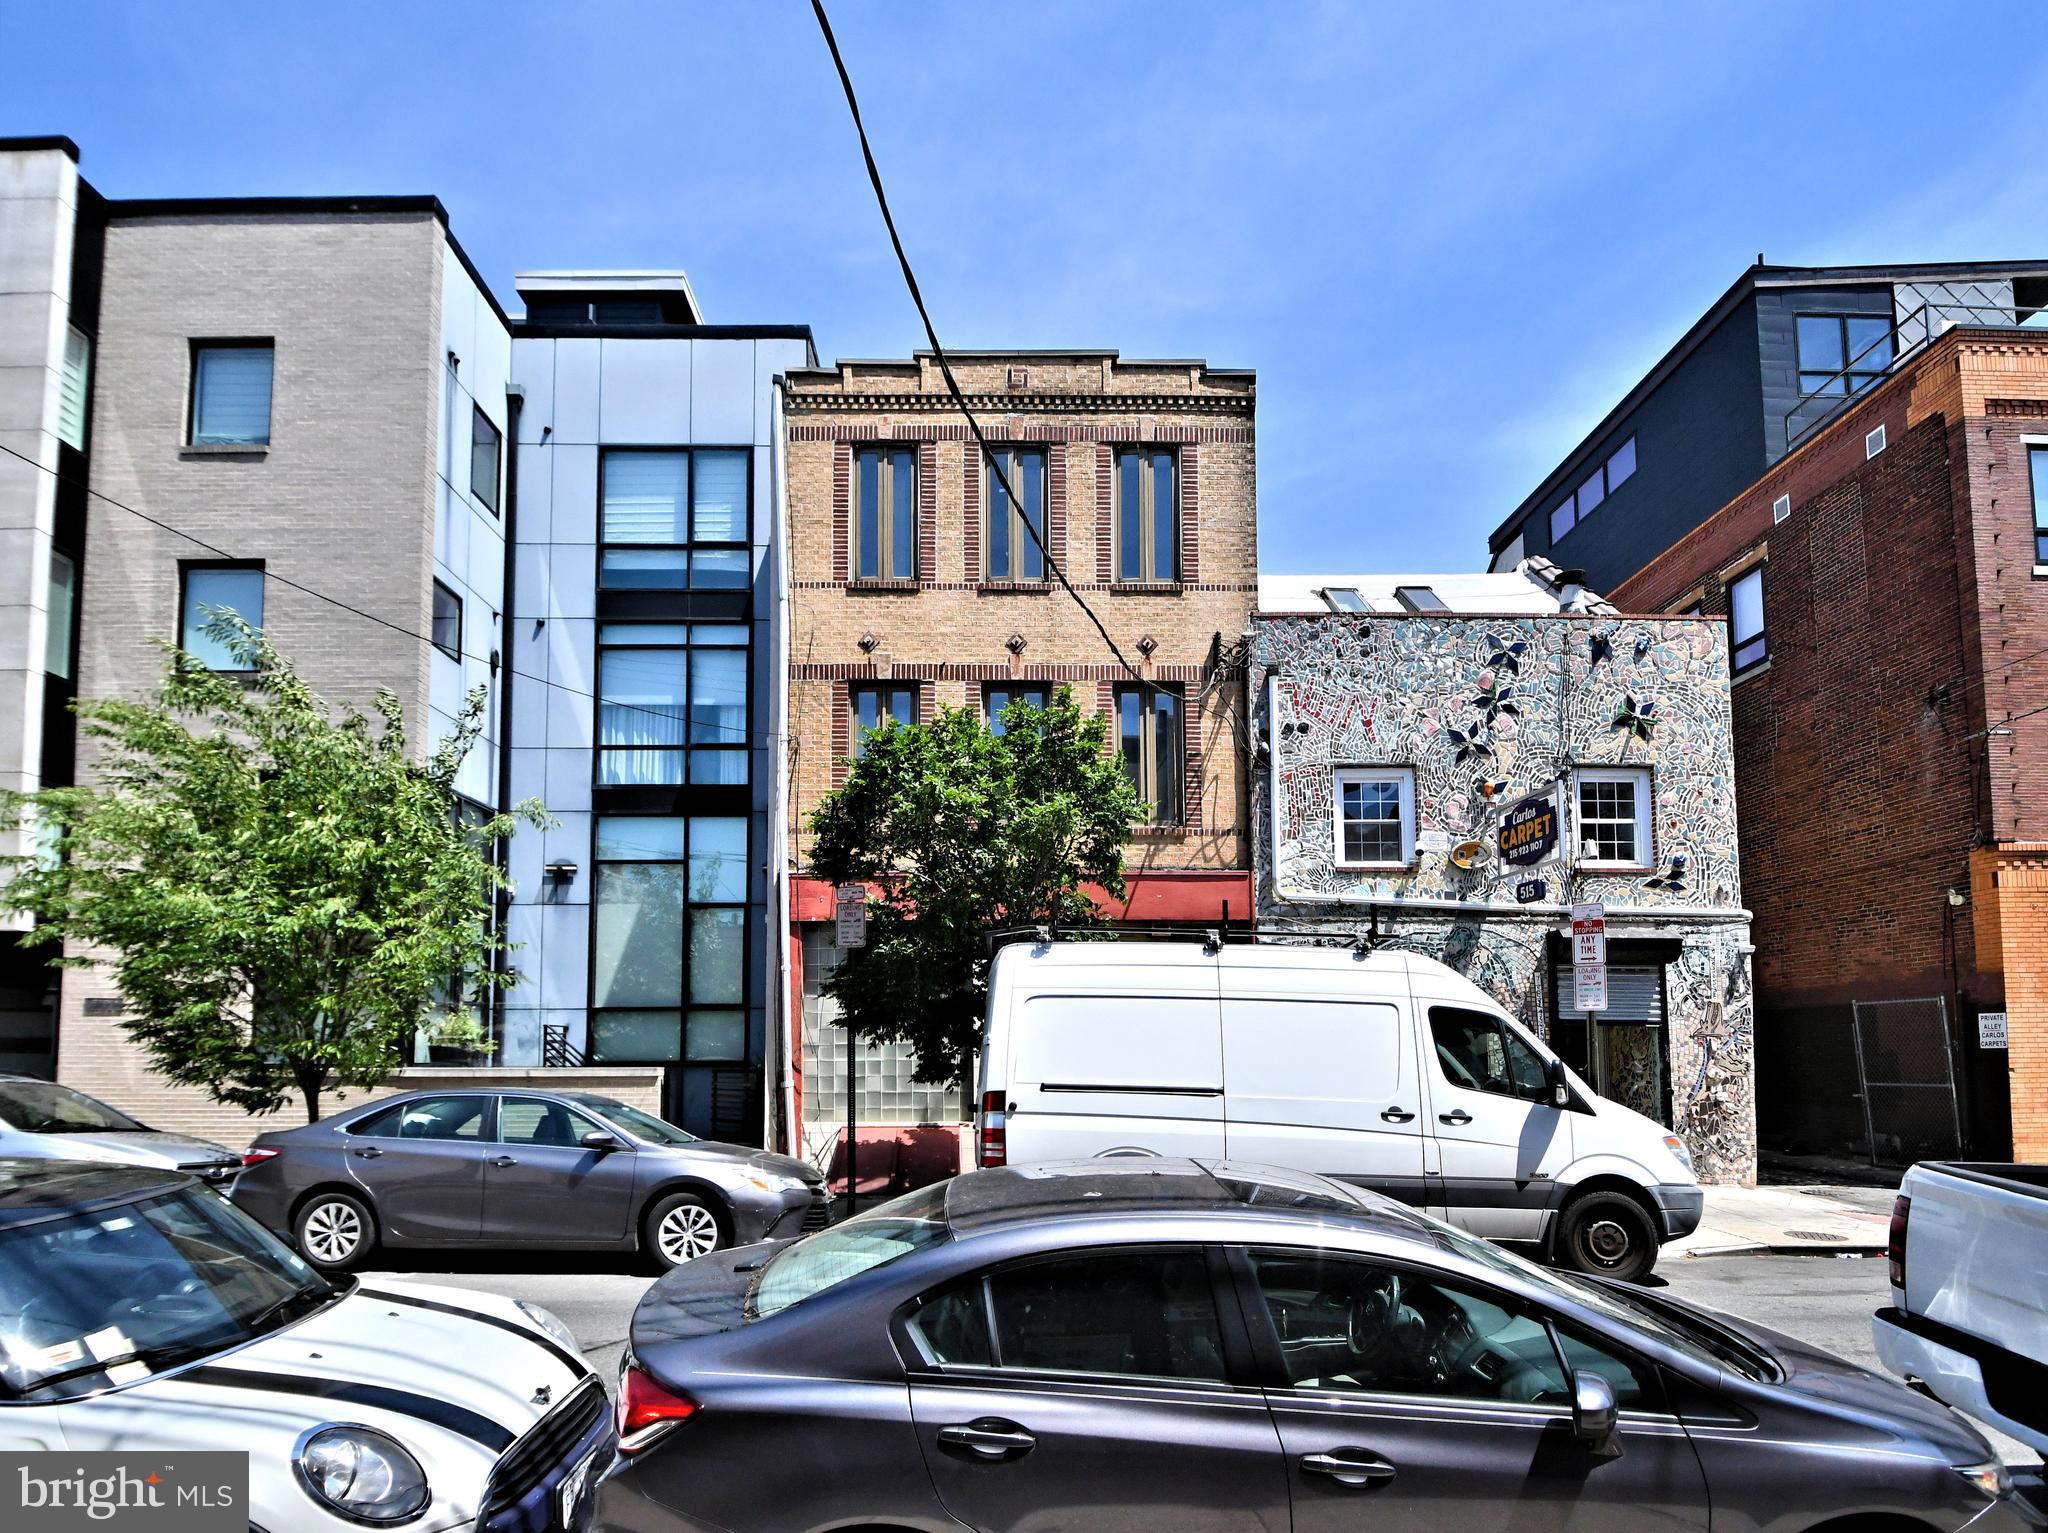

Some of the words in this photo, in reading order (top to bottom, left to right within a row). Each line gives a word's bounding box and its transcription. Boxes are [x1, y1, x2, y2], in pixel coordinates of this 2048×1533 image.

[1512, 807, 1536, 825] Carlos
[1500, 813, 1551, 850] CARPET
[1520, 884, 1535, 899] 515
[1574, 926, 1603, 934] STOPPING
[1580, 935, 1596, 944] ANY
[1580, 945, 1597, 955] TIME
[1582, 973, 1597, 981] ONLY
